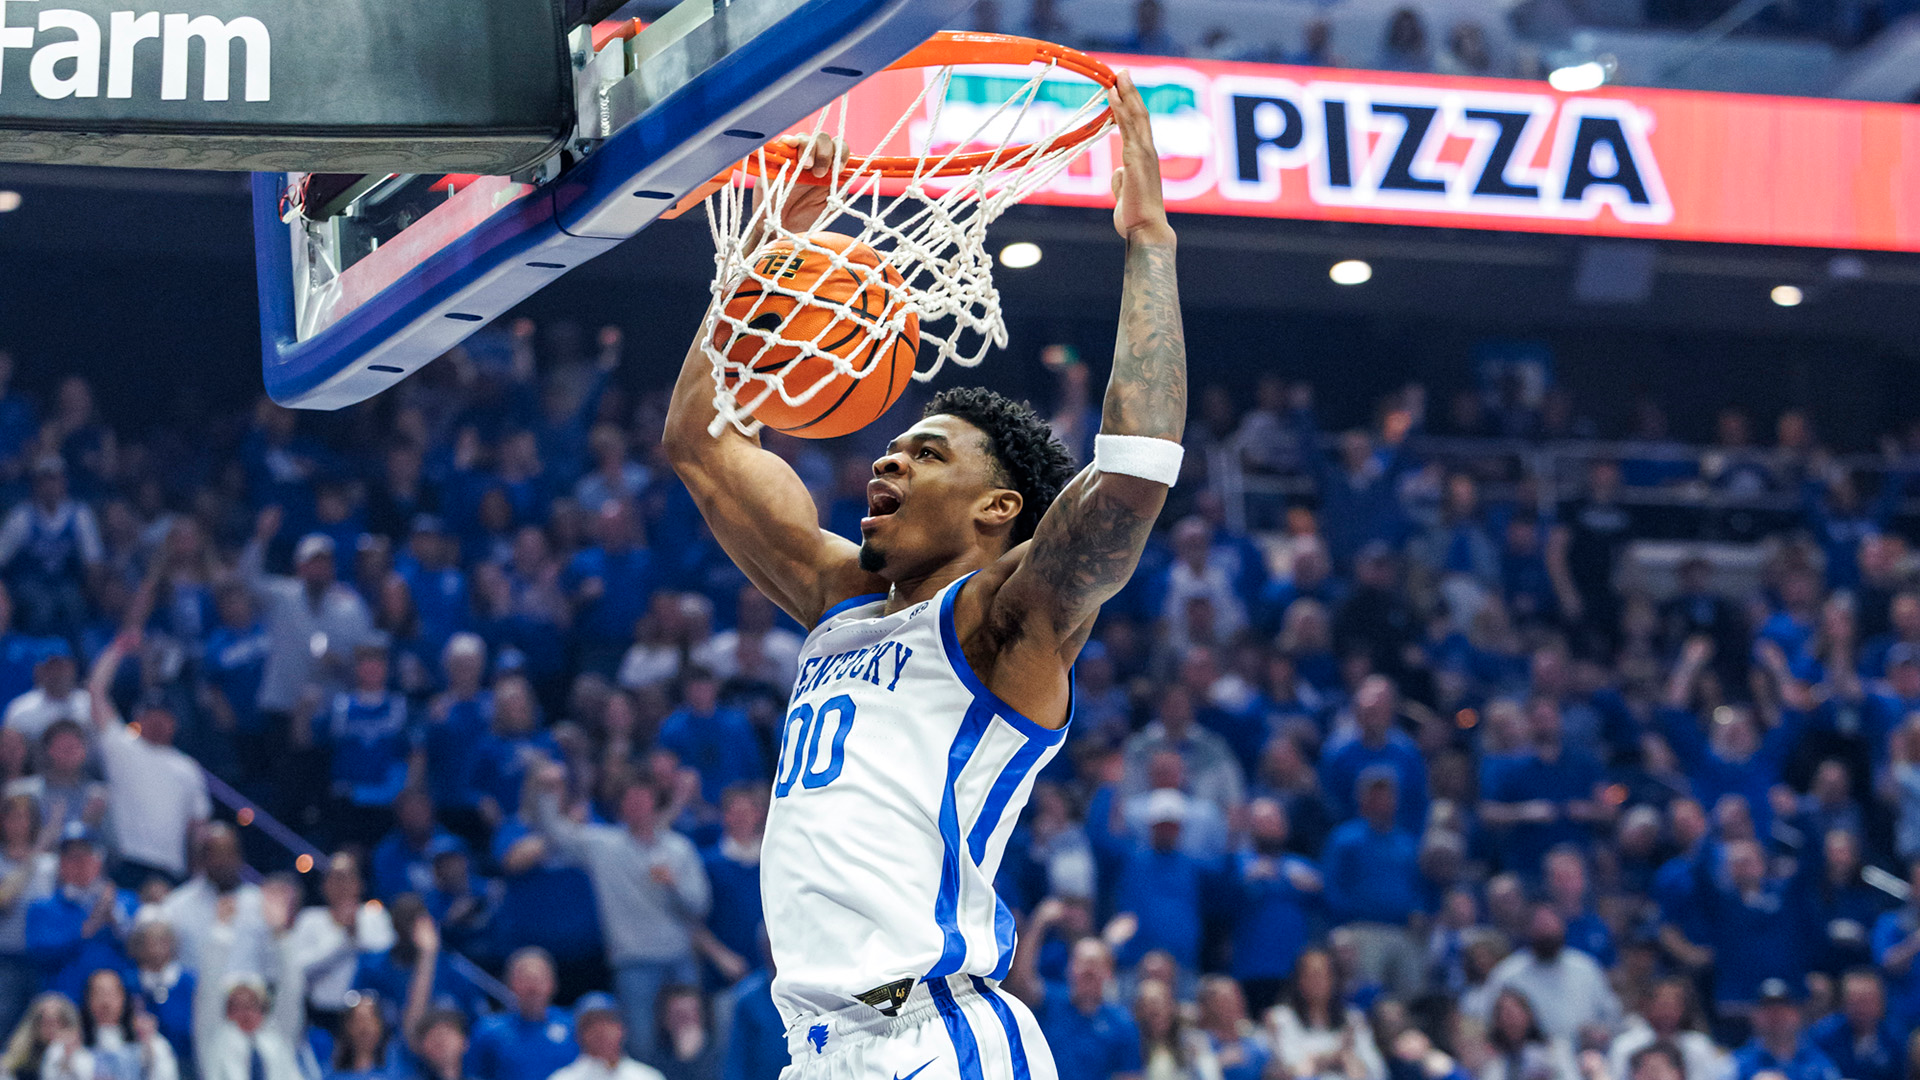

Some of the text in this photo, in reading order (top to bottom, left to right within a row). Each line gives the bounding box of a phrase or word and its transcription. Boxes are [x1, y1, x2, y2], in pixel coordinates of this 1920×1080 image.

[0, 0, 271, 102] arm
[1231, 94, 1652, 206] PIZZA
[793, 640, 914, 704] ENTUCKY
[775, 693, 857, 799] 00
